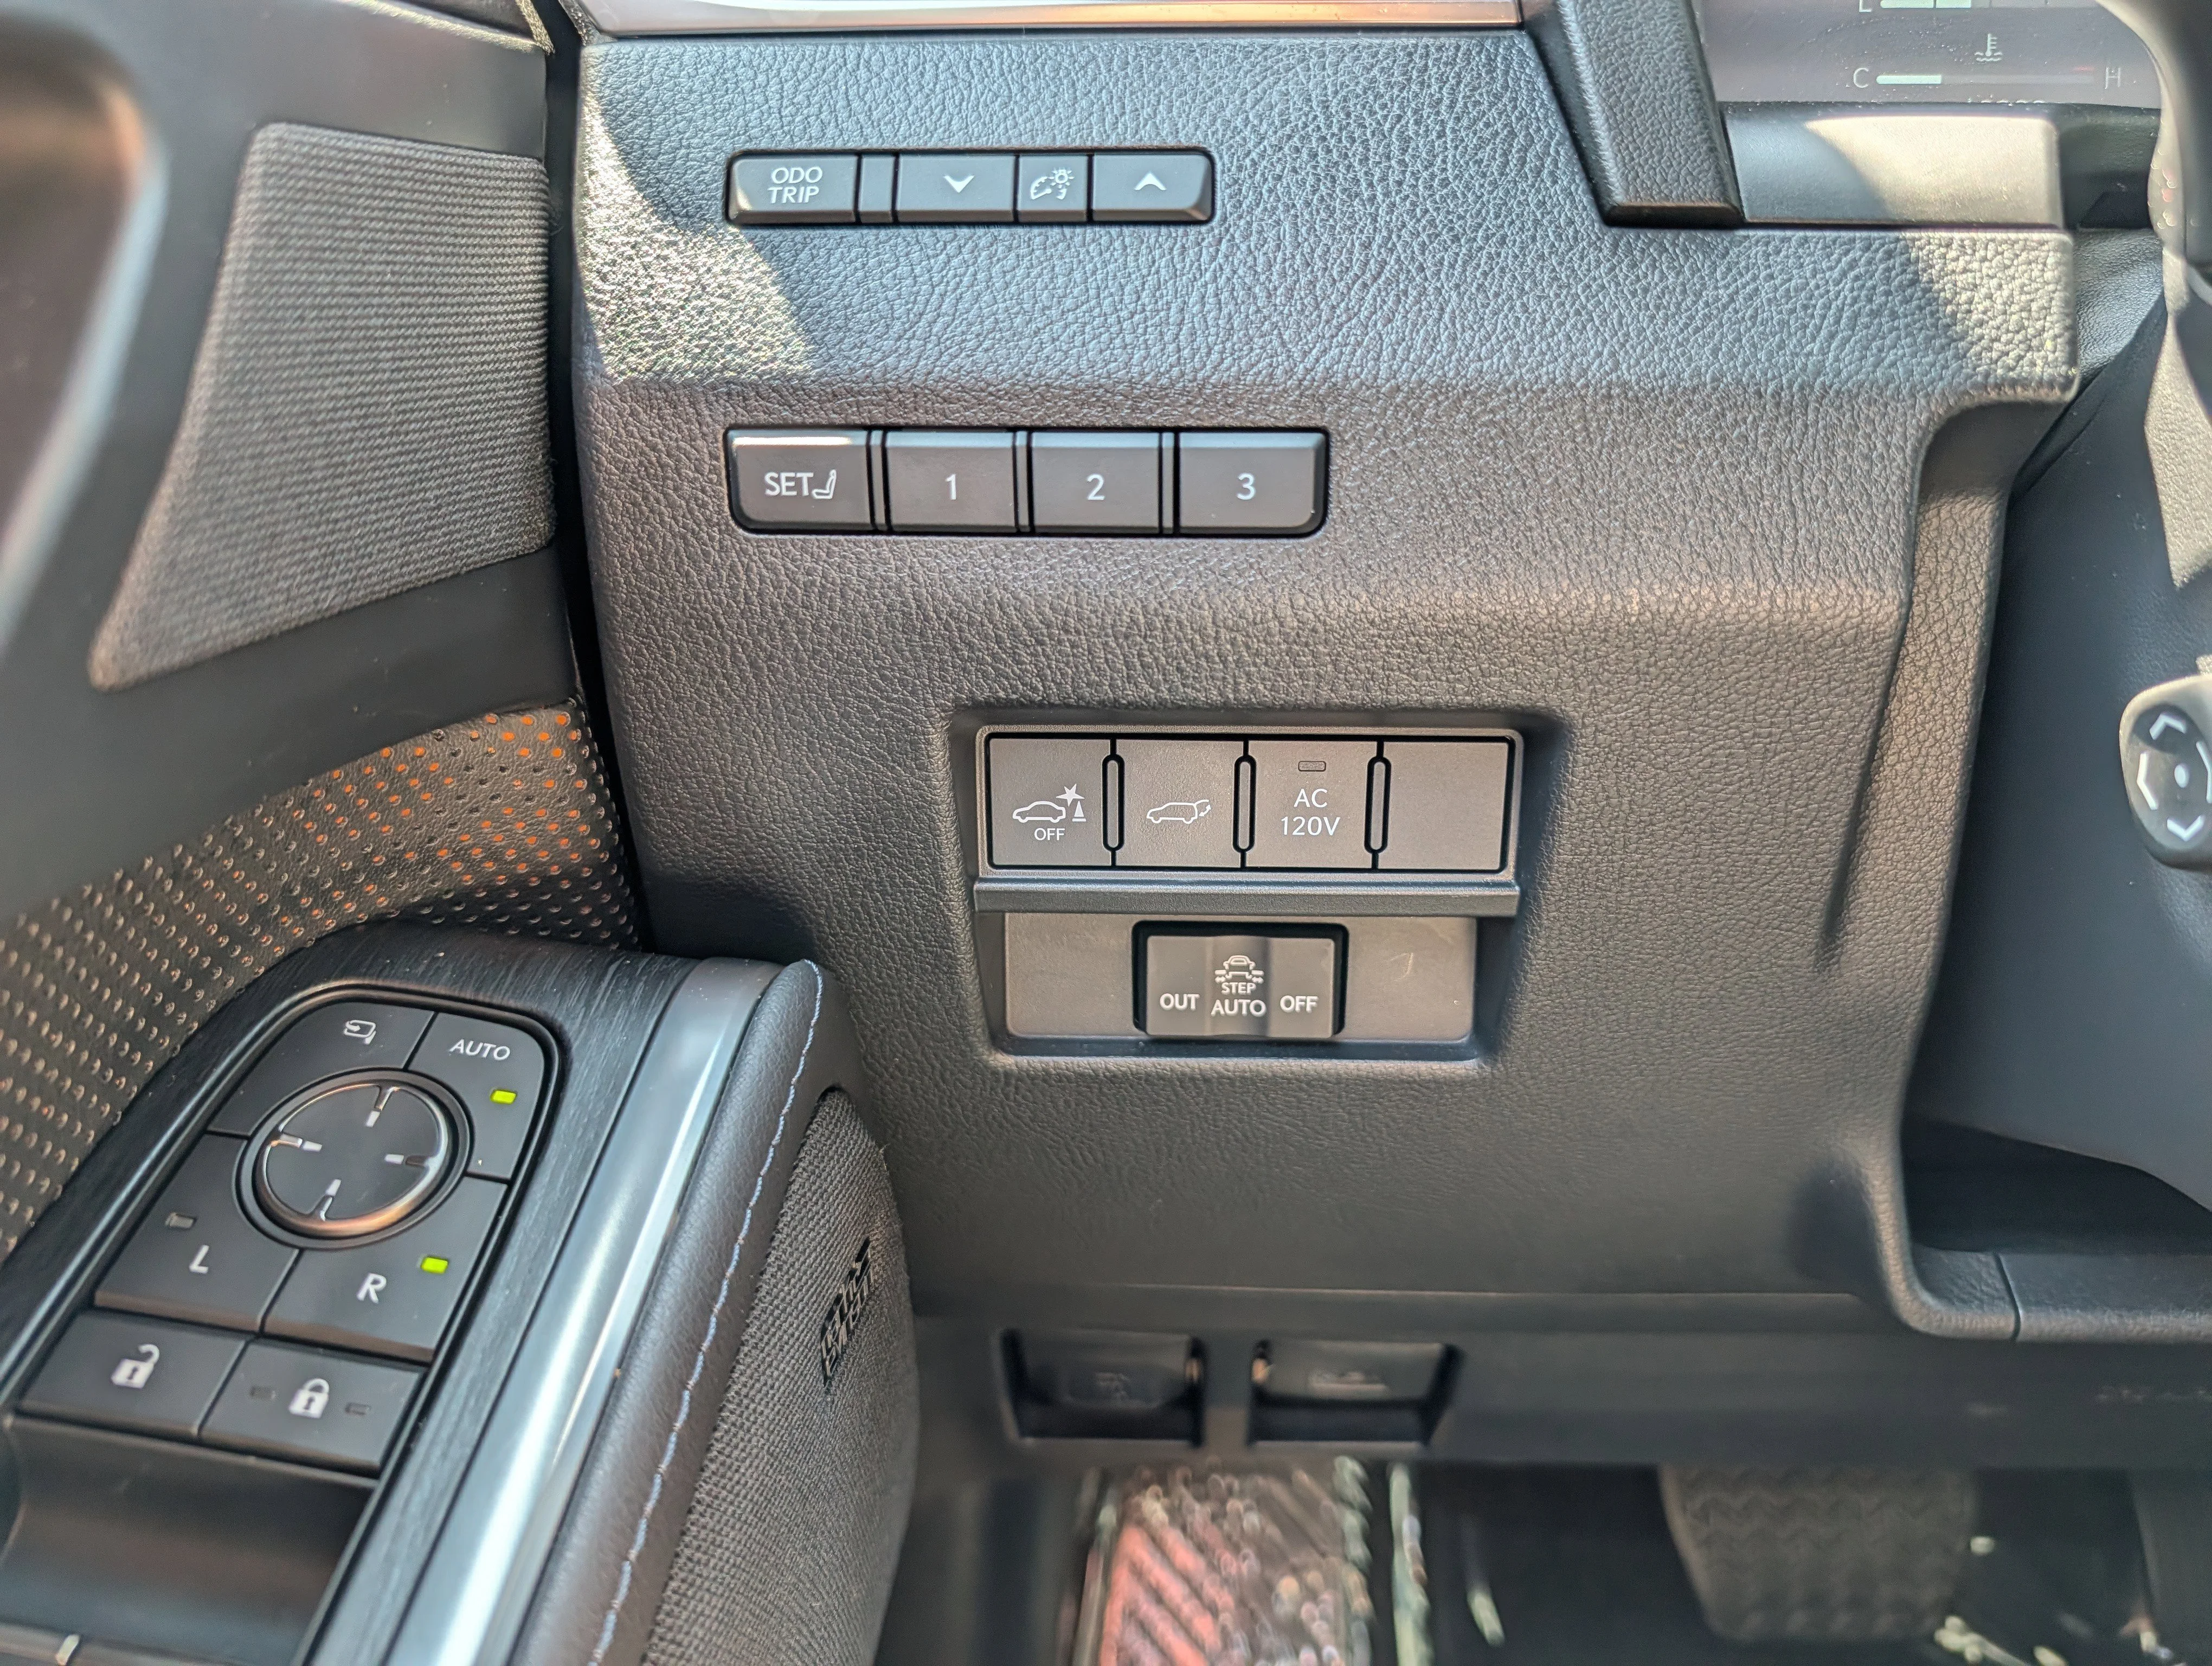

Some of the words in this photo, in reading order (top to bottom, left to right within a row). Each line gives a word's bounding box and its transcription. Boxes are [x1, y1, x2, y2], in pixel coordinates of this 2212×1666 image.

[1853, 67, 1869, 88] C
[2105, 67, 2121, 88] H
[771, 166, 823, 184] ODO
[767, 185, 819, 204] TRIP
[764, 472, 813, 496] SET
[944, 473, 957, 500] 1
[1086, 474, 1105, 501] 2
[1236, 473, 1256, 500] 3
[1293, 788, 1328, 808] AC
[1033, 828, 1065, 841] OFF
[1281, 816, 1341, 836] 120V
[1221, 981, 1257, 994] STEP
[1159, 993, 1200, 1010] OUT
[1210, 999, 1266, 1016] AUTO
[1279, 995, 1319, 1013] OFF
[449, 1039, 511, 1061] AUTO
[189, 1245, 210, 1274] L
[357, 1273, 387, 1303] R
